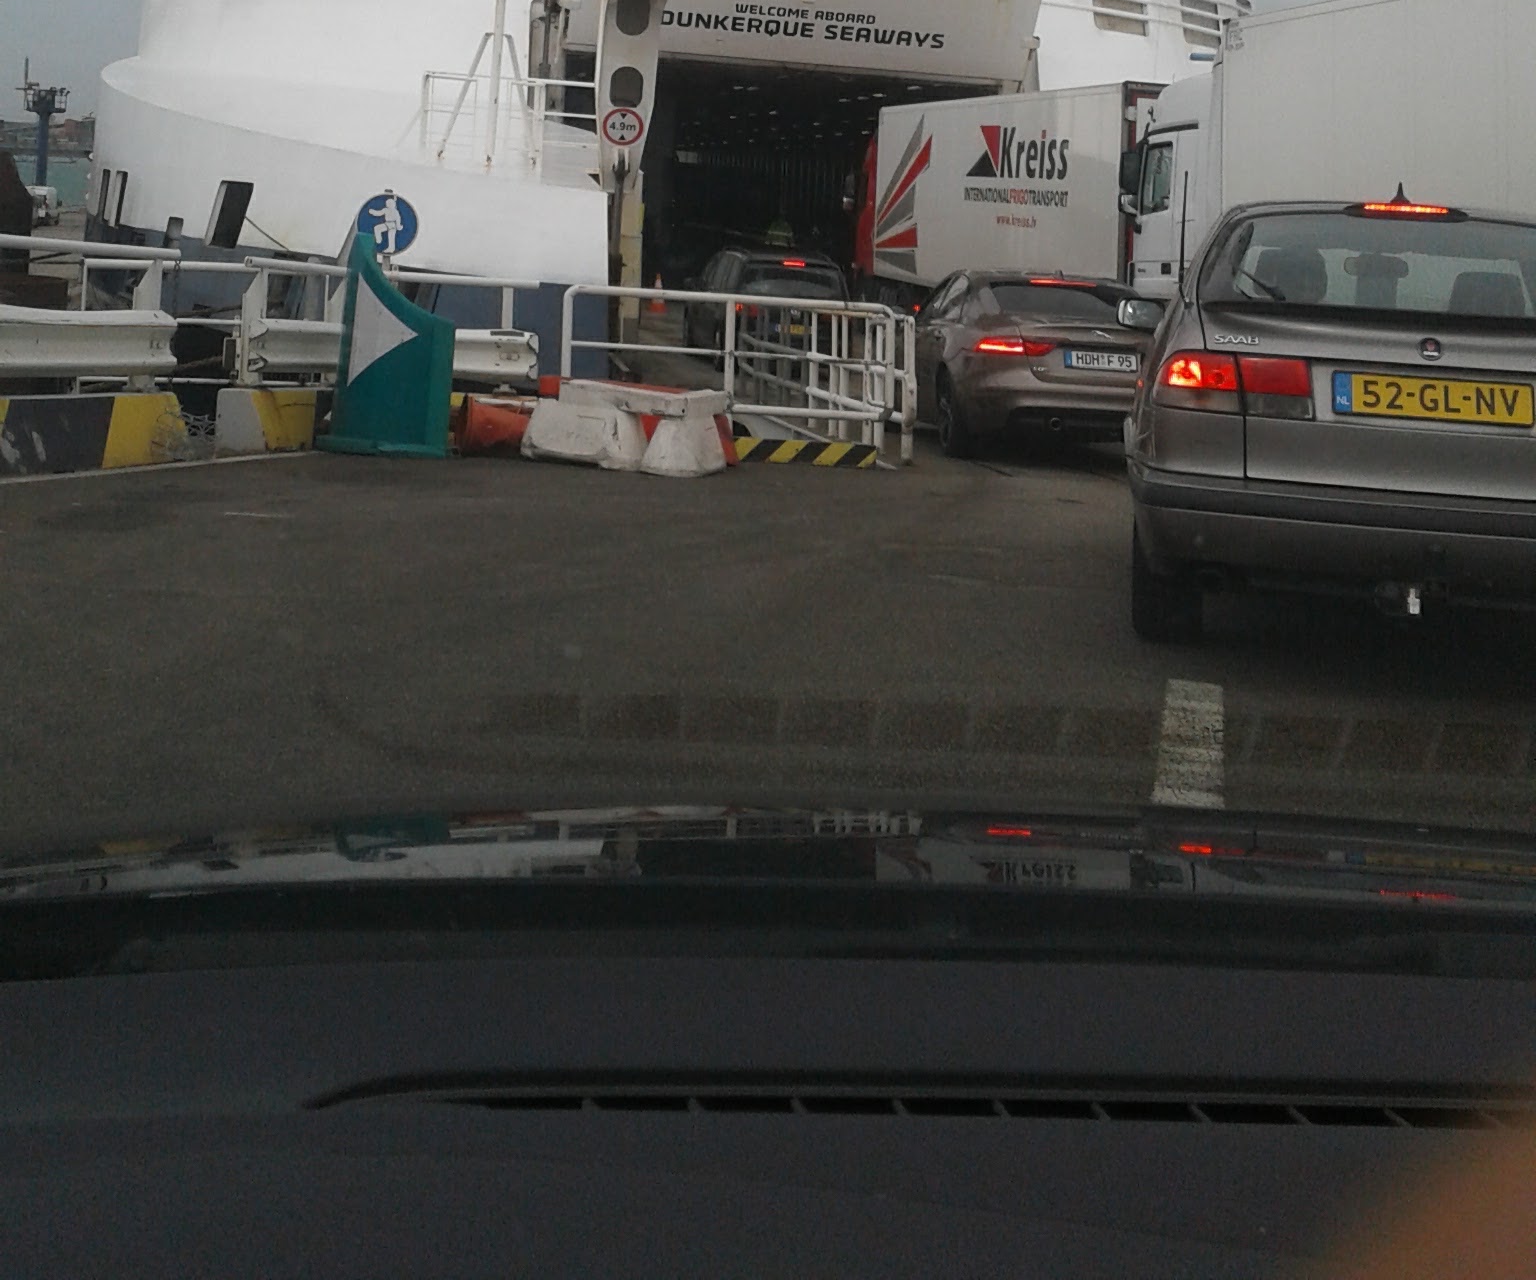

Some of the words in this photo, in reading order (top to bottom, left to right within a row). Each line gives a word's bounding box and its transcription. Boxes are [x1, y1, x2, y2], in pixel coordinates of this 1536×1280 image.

[735, 3, 809, 19] WELCOME
[814, 10, 876, 25] ABOARD
[660, 10, 815, 38] DUNKERQUE
[824, 24, 945, 49] SEAWAYS
[609, 121, 637, 131] 4.9m
[1000, 126, 1070, 180] Kreiss
[1214, 334, 1259, 345] SAAB
[1336, 395, 1350, 405] NL
[1362, 380, 1519, 417] 52-GL-NV
